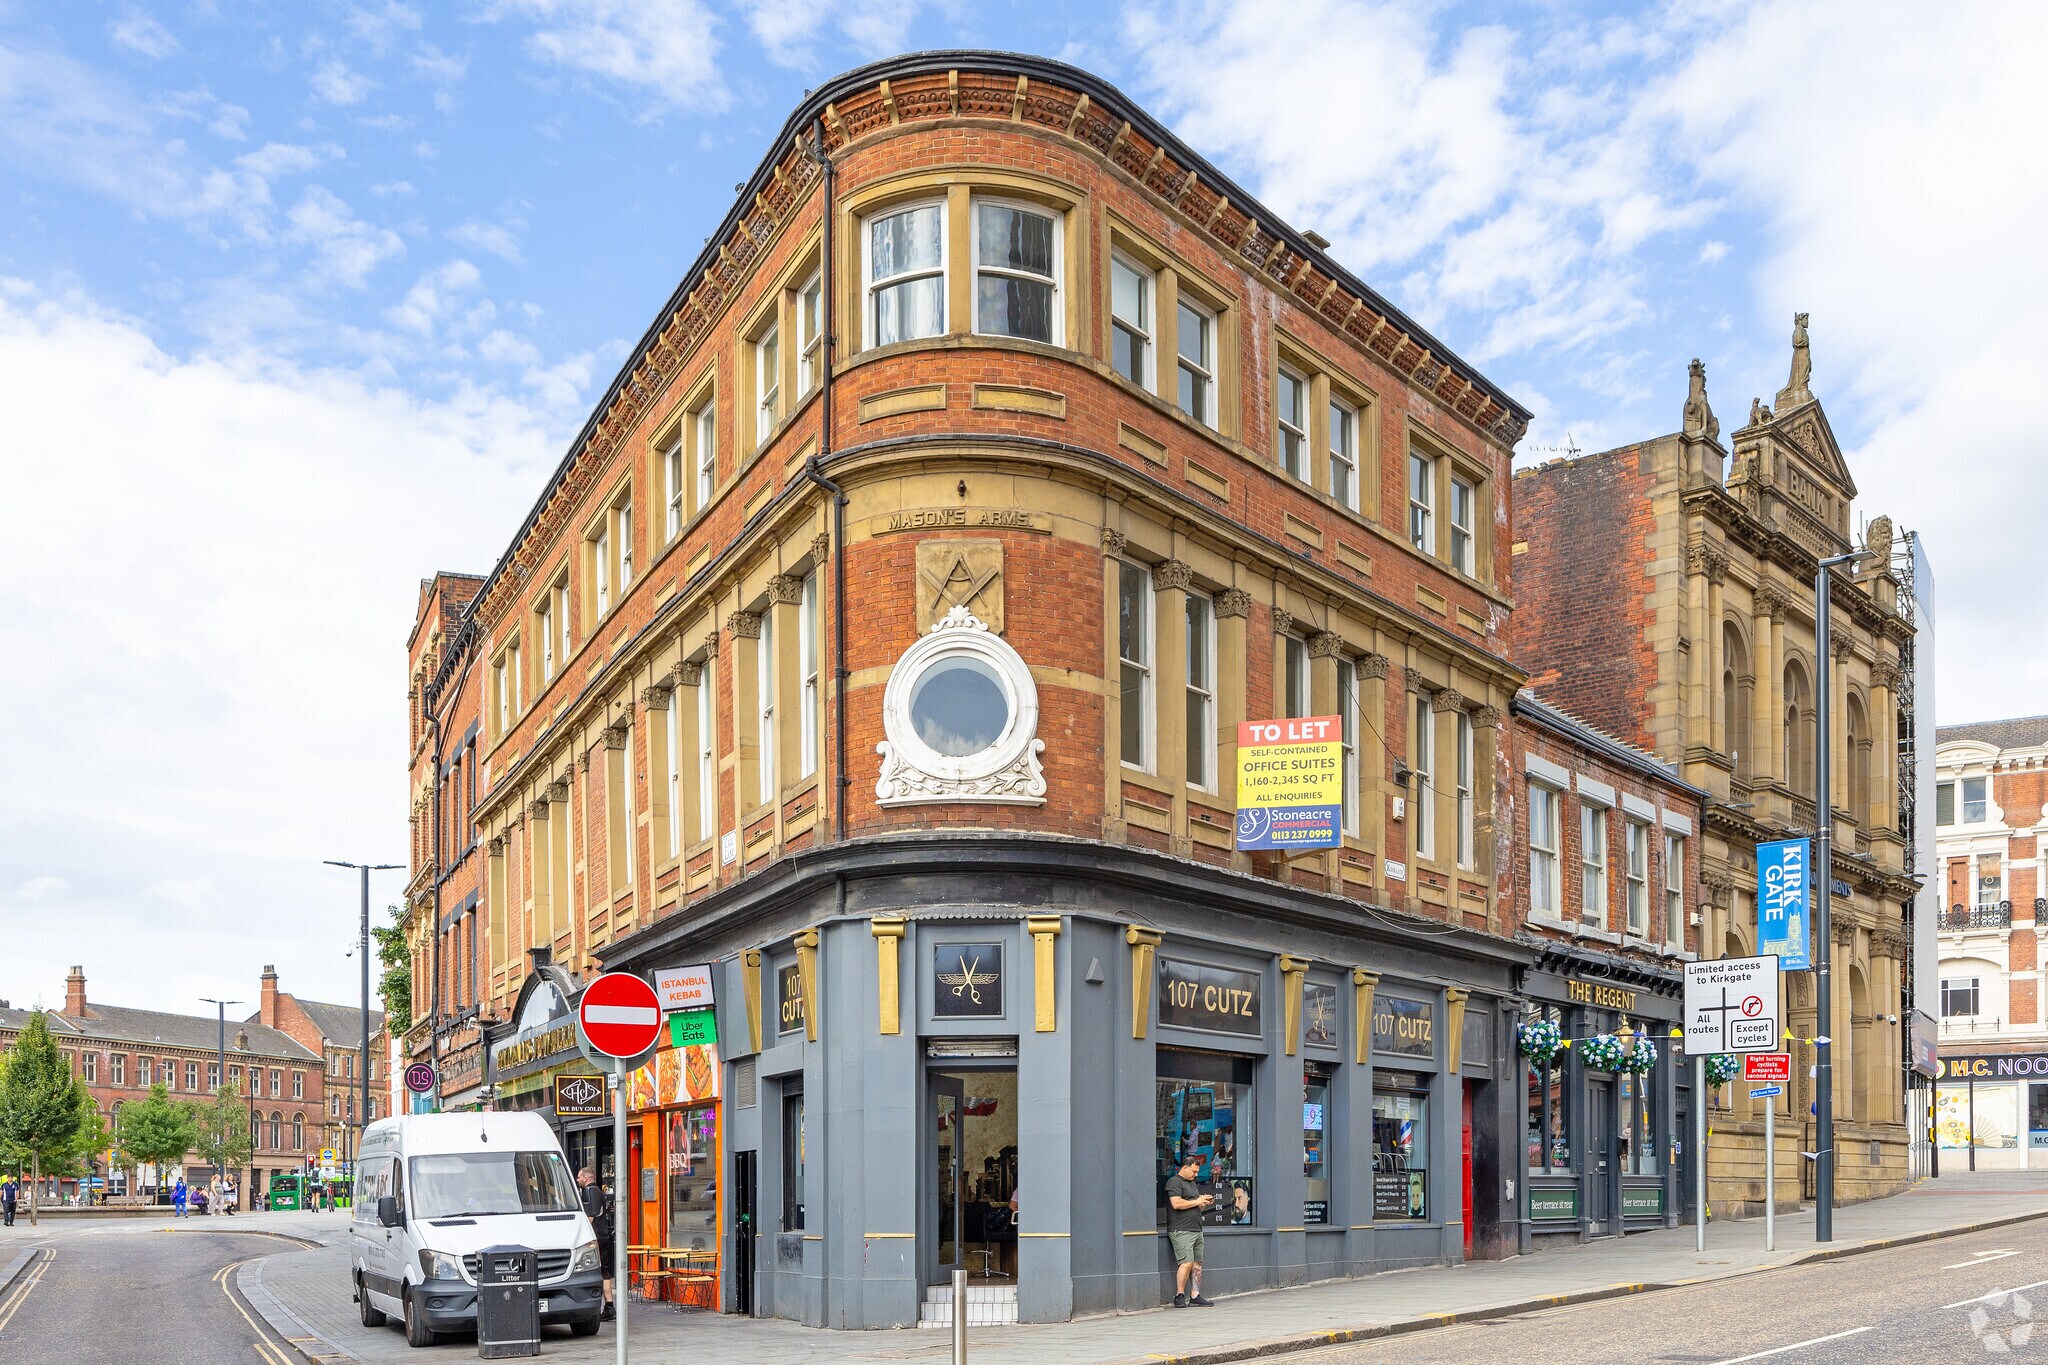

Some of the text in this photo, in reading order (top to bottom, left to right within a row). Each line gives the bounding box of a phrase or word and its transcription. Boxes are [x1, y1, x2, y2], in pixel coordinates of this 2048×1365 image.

[1788, 469, 1826, 520] BANK
[888, 508, 966, 530] MASON'S
[1249, 720, 1330, 742] TO LET
[1250, 745, 1328, 757] SELF-CONTAINED
[1243, 758, 1335, 772] OFFICE SUITES
[1245, 773, 1335, 787] 1,160-2,345 SQ FT
[1255, 791, 1323, 802] ALL ENQUIRIES
[1271, 809, 1332, 821] Stoneacre
[1271, 820, 1332, 829] COMMERCIAL
[1271, 829, 1333, 840] 0113 237 0999
[1783, 845, 1802, 908] KIRK
[1765, 864, 1784, 922] GATE
[1688, 962, 1761, 975] Limited access
[661, 976, 707, 989] ISTANBUL
[1696, 973, 1752, 985] to Kirkgate
[669, 989, 702, 1001] KEBAB
[1167, 979, 1253, 1017] 107 CUTZ
[1569, 980, 1636, 1010] THE REGENT
[1697, 1014, 1711, 1023] All
[681, 1022, 704, 1031] Uber
[1373, 1012, 1432, 1041] 107 CUTZ
[1688, 1025, 1720, 1034] routes
[1736, 1023, 1769, 1034] Except
[682, 1031, 705, 1041] Eats
[1737, 1033, 1767, 1044] cycles
[1950, 1059, 1993, 1077] M.C.
[669, 1152, 687, 1169] BBQ
[1531, 1199, 1574, 1210] Beer terrace at rear
[1623, 1198, 1633, 1207] Beer
[1633, 1199, 1646, 1207] terrace
[1646, 1199, 1651, 1207] at
